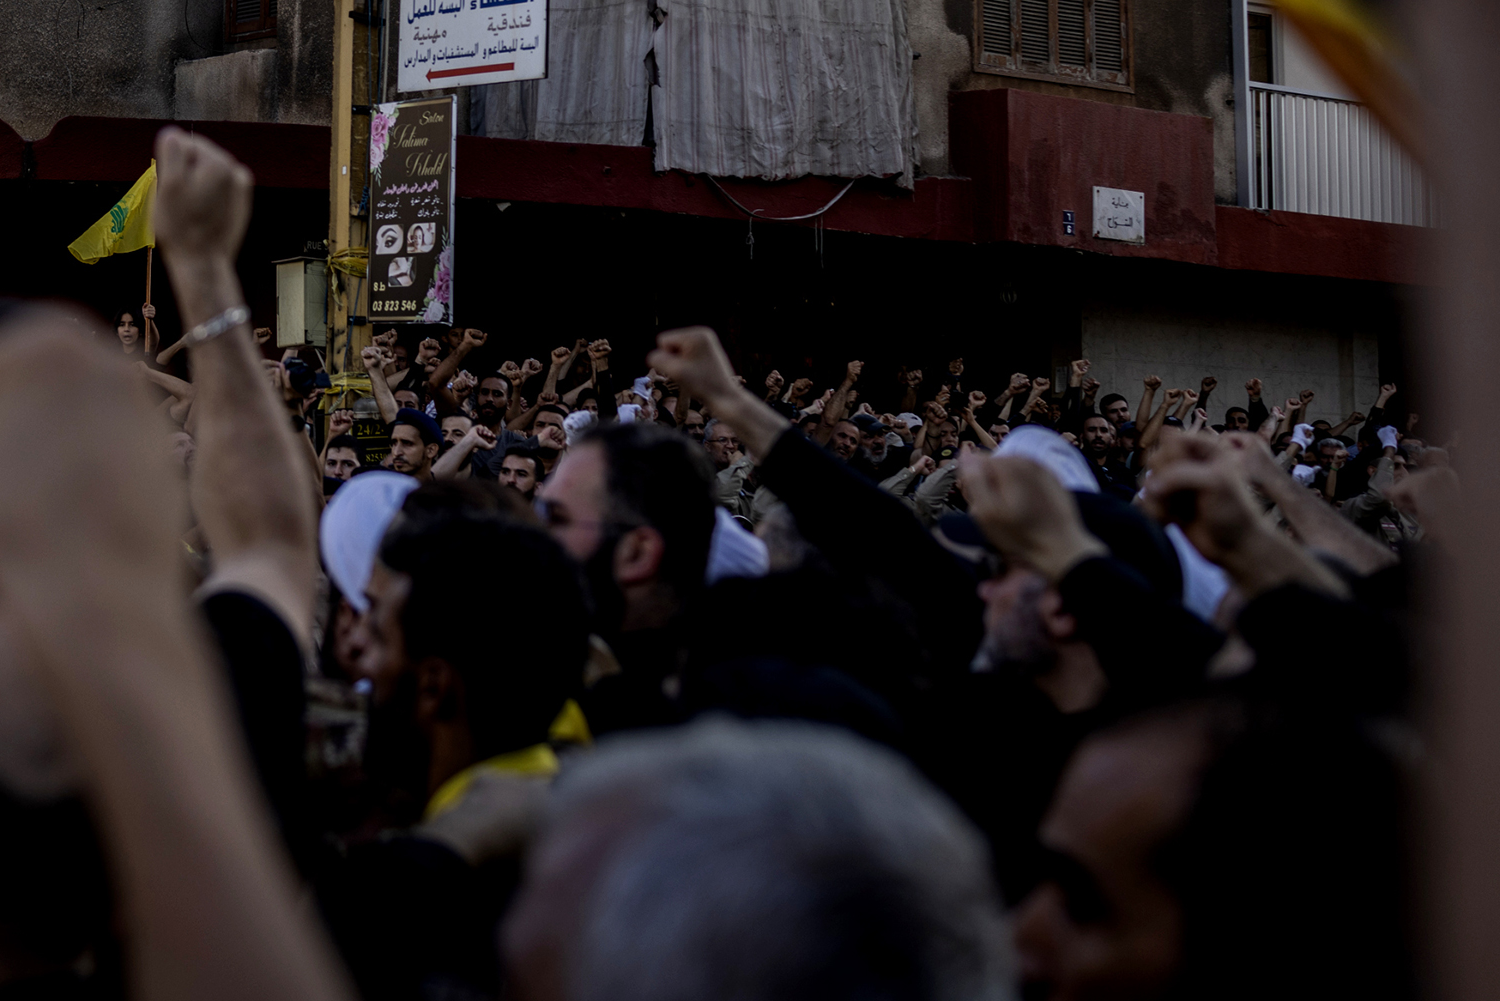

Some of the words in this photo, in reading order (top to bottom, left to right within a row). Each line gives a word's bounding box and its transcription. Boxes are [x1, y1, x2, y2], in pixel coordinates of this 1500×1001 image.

[487, 10, 532, 36] فندقية
[413, 26, 447, 45] مهنية
[419, 110, 445, 126] Salon
[1066, 225, 1072, 233] 6
[306, 240, 322, 250] RUE
[372, 300, 383, 312] 03
[384, 300, 399, 311] 823
[401, 300, 417, 311] 546
